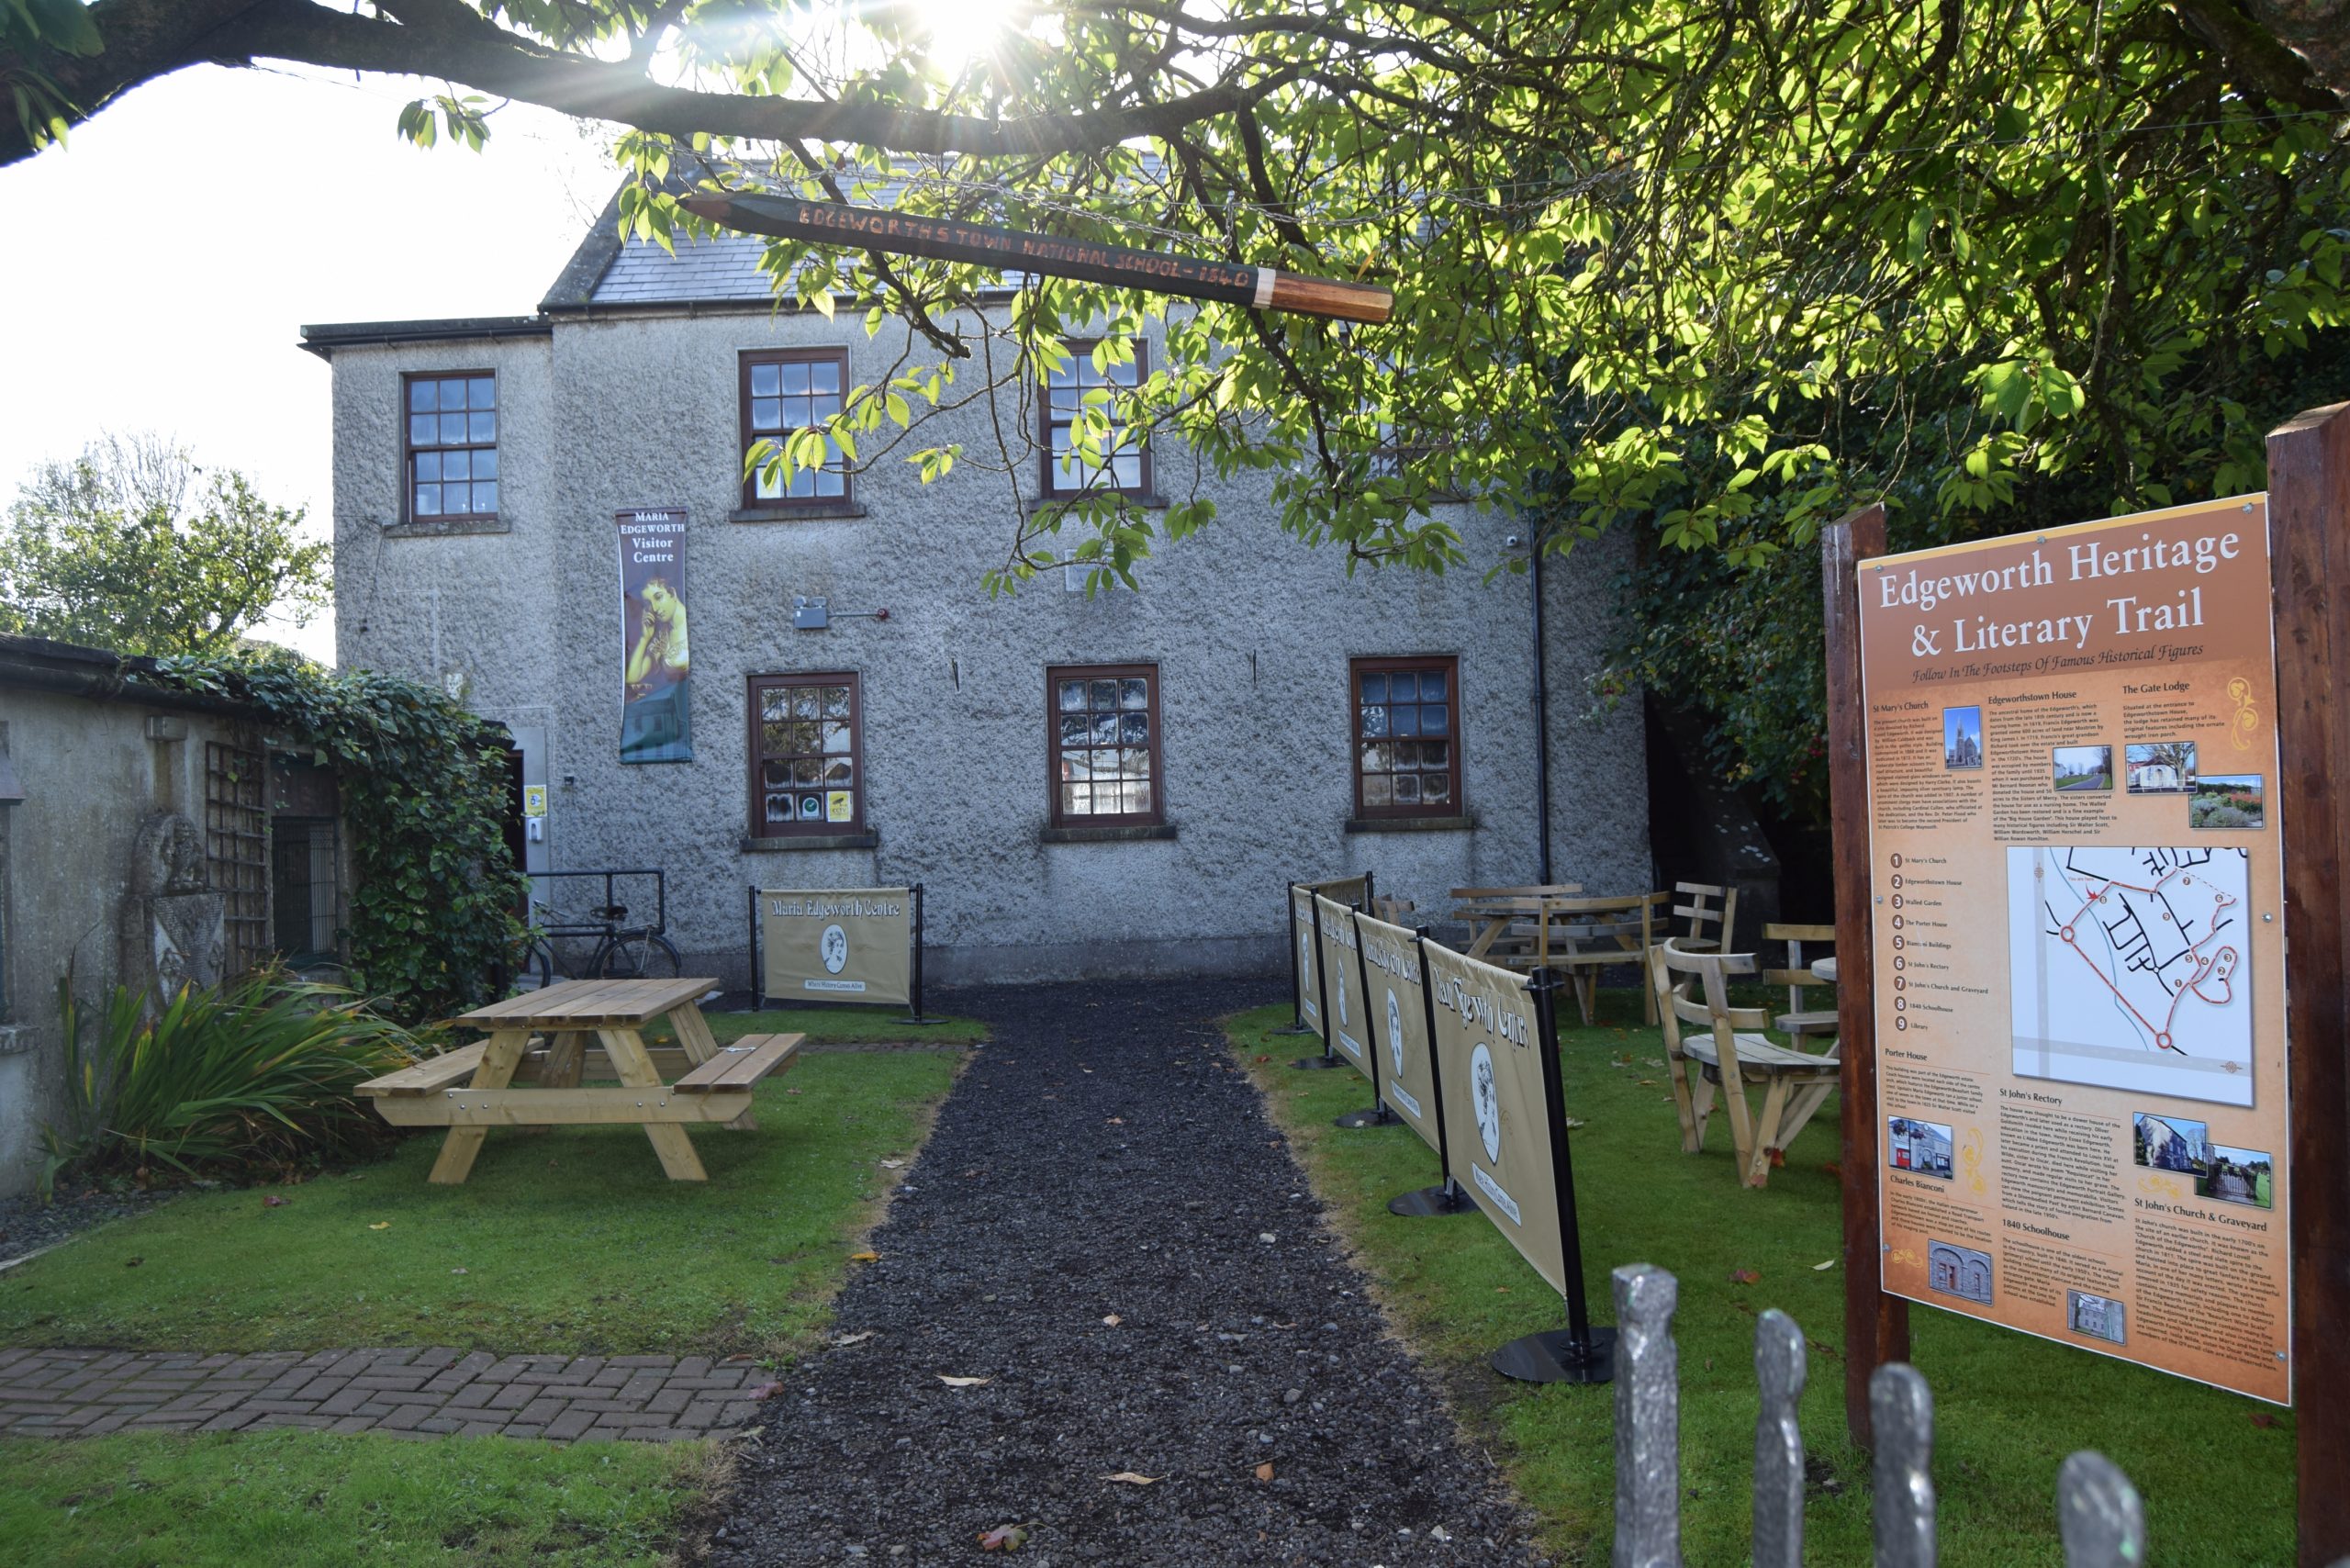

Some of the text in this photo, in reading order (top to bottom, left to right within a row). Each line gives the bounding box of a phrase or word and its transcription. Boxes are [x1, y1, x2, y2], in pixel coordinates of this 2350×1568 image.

[1022, 240, 1110, 268] NATIONAL
[1198, 265, 1249, 287] 1840
[635, 512, 669, 521] MARIA
[621, 523, 685, 534] EDGEWORTH
[632, 537, 674, 549] Visitor
[633, 551, 675, 564] Centre
[1879, 532, 2239, 610] Edgeworth Heritage
[1912, 587, 2204, 656] & Literary Trail
[1912, 644, 2202, 683] Follow In The Footsteps Of Famous Historical Figures
[2122, 680, 2189, 693] The Gate Lodge
[1988, 693, 2049, 705] Edgeworthstown
[1873, 704, 1879, 712] St
[1904, 700, 1928, 710] Church
[1894, 856, 1897, 865] 1
[1894, 876, 1899, 886] 2
[1895, 896, 1900, 906] 3
[1893, 917, 1900, 927] 4
[1896, 937, 1901, 947] 5
[1928, 941, 1951, 949] Buildings
[1896, 958, 1902, 968] 6
[1897, 978, 1902, 988] 7
[1897, 999, 1903, 1009] 8
[1897, 1018, 1904, 1028] 9
[1885, 1047, 1927, 1060] Porter House
[1999, 1088, 2061, 1105] St John's Rectory
[1890, 1174, 1943, 1193] Charles Bianconi
[2134, 1197, 2266, 1231] St John's Church & Graveyard
[2003, 1218, 2069, 1239] 1840 Schoolhouse
